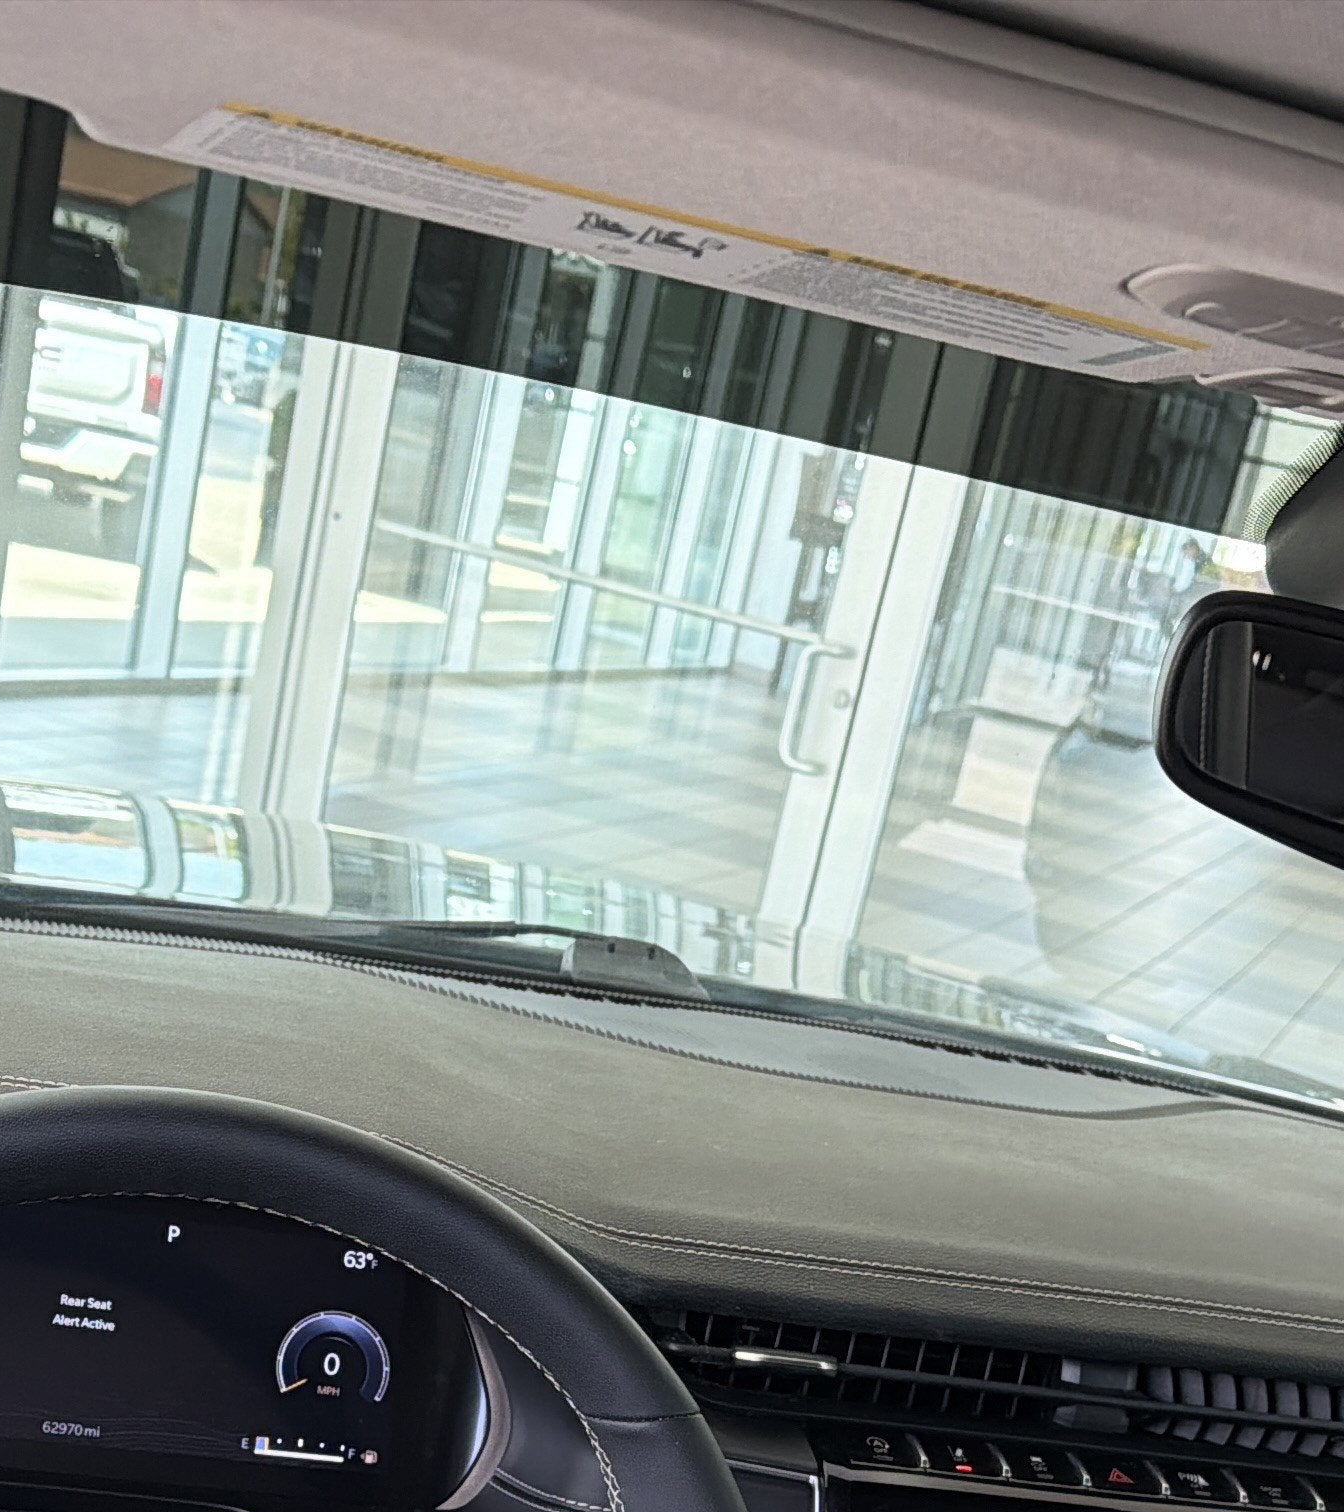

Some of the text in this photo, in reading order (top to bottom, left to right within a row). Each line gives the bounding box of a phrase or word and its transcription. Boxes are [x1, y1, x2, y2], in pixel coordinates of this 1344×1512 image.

[167, 1225, 181, 1243] P
[60, 1293, 113, 1312] Rear Seat
[52, 1314, 116, 1333] Alert Active
[322, 1352, 341, 1377] 0
[316, 1385, 341, 1398] MPH
[241, 1437, 250, 1450] E
[347, 1448, 356, 1461] F
